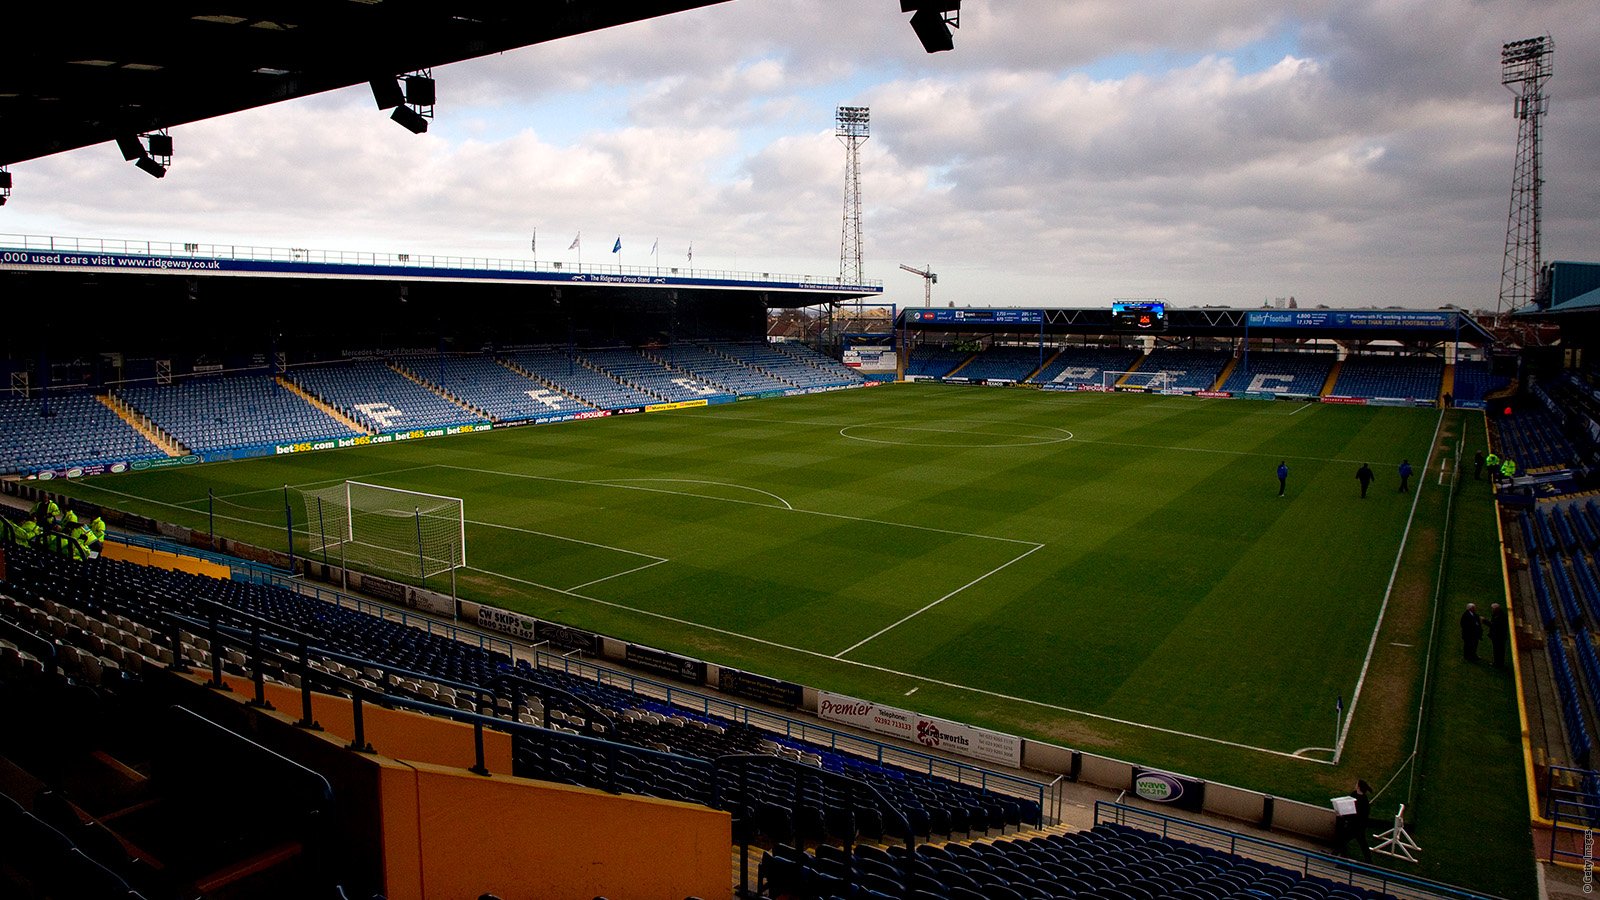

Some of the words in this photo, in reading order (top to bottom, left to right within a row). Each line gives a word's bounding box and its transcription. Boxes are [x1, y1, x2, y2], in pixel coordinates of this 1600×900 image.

[32, 254, 60, 264] used
[64, 256, 88, 265] cars
[91, 256, 115, 266] visit
[118, 258, 220, 269] www.ridgeway.co.uk
[600, 275, 622, 283] Ridgeway
[1052, 367, 1099, 383] P
[1246, 374, 1295, 392] C
[354, 403, 402, 427] P
[523, 388, 564, 410] F
[276, 442, 335, 455] bet365.com
[339, 435, 392, 447] bet365.com
[395, 429, 444, 440] bet365.com
[447, 424, 491, 434] bet365.com
[479, 609, 492, 619] CW
[495, 612, 520, 627] SKIPS
[480, 618, 497, 629] 0800
[498, 623, 511, 633] 234
[513, 627, 518, 635] 3
[519, 629, 534, 638] 567
[820, 700, 874, 715] Premier
[879, 709, 908, 721] Telephone:
[1138, 781, 1166, 789] wave
